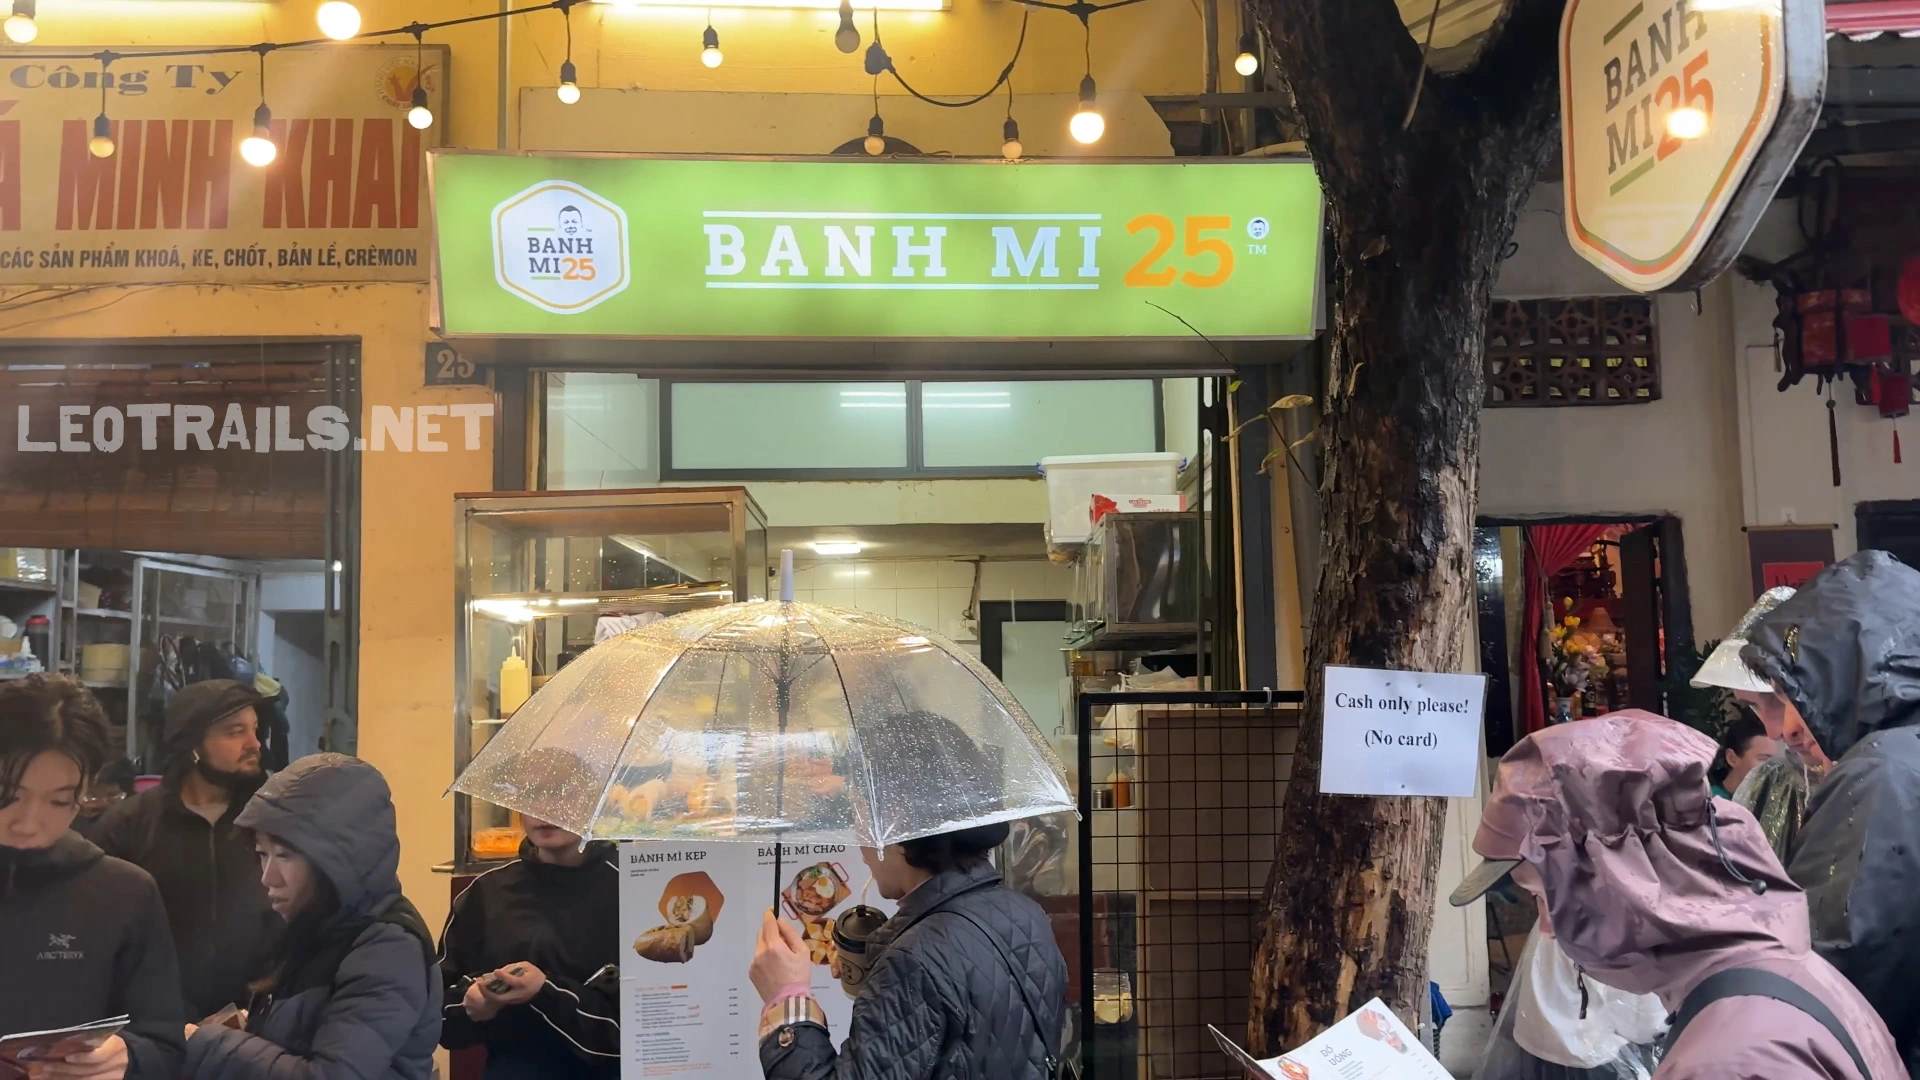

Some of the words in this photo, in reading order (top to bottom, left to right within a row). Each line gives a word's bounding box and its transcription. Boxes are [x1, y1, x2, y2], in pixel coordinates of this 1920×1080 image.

[10, 64, 149, 96] Công
[165, 65, 242, 95] Ty
[55, 119, 234, 231] MINH
[262, 118, 421, 229] KHAI
[0, 246, 34, 269] CÁC
[39, 242, 75, 268] SẢN
[79, 241, 130, 268] PHẨM
[135, 245, 186, 270] KHOÁ,
[191, 248, 219, 269] KE,
[223, 241, 273, 269] CHỐT,
[277, 242, 312, 267] BẢN
[527, 236, 594, 254] BANH
[703, 224, 947, 277] BANH
[991, 226, 1101, 277] MI
[1123, 213, 1236, 289] 25
[1247, 244, 1268, 255] TM
[437, 349, 476, 379] 25
[1335, 692, 1373, 709] Cash
[1378, 696, 1412, 715] only
[1416, 697, 1469, 715] please!
[1364, 729, 1393, 748] (No
[1397, 732, 1438, 750] card)
[630, 853, 664, 864] BÁNH
[667, 850, 682, 862] MÌ
[685, 850, 707, 861] KẸP
[757, 846, 791, 857] BÁH
[795, 844, 810, 855] MÌ
